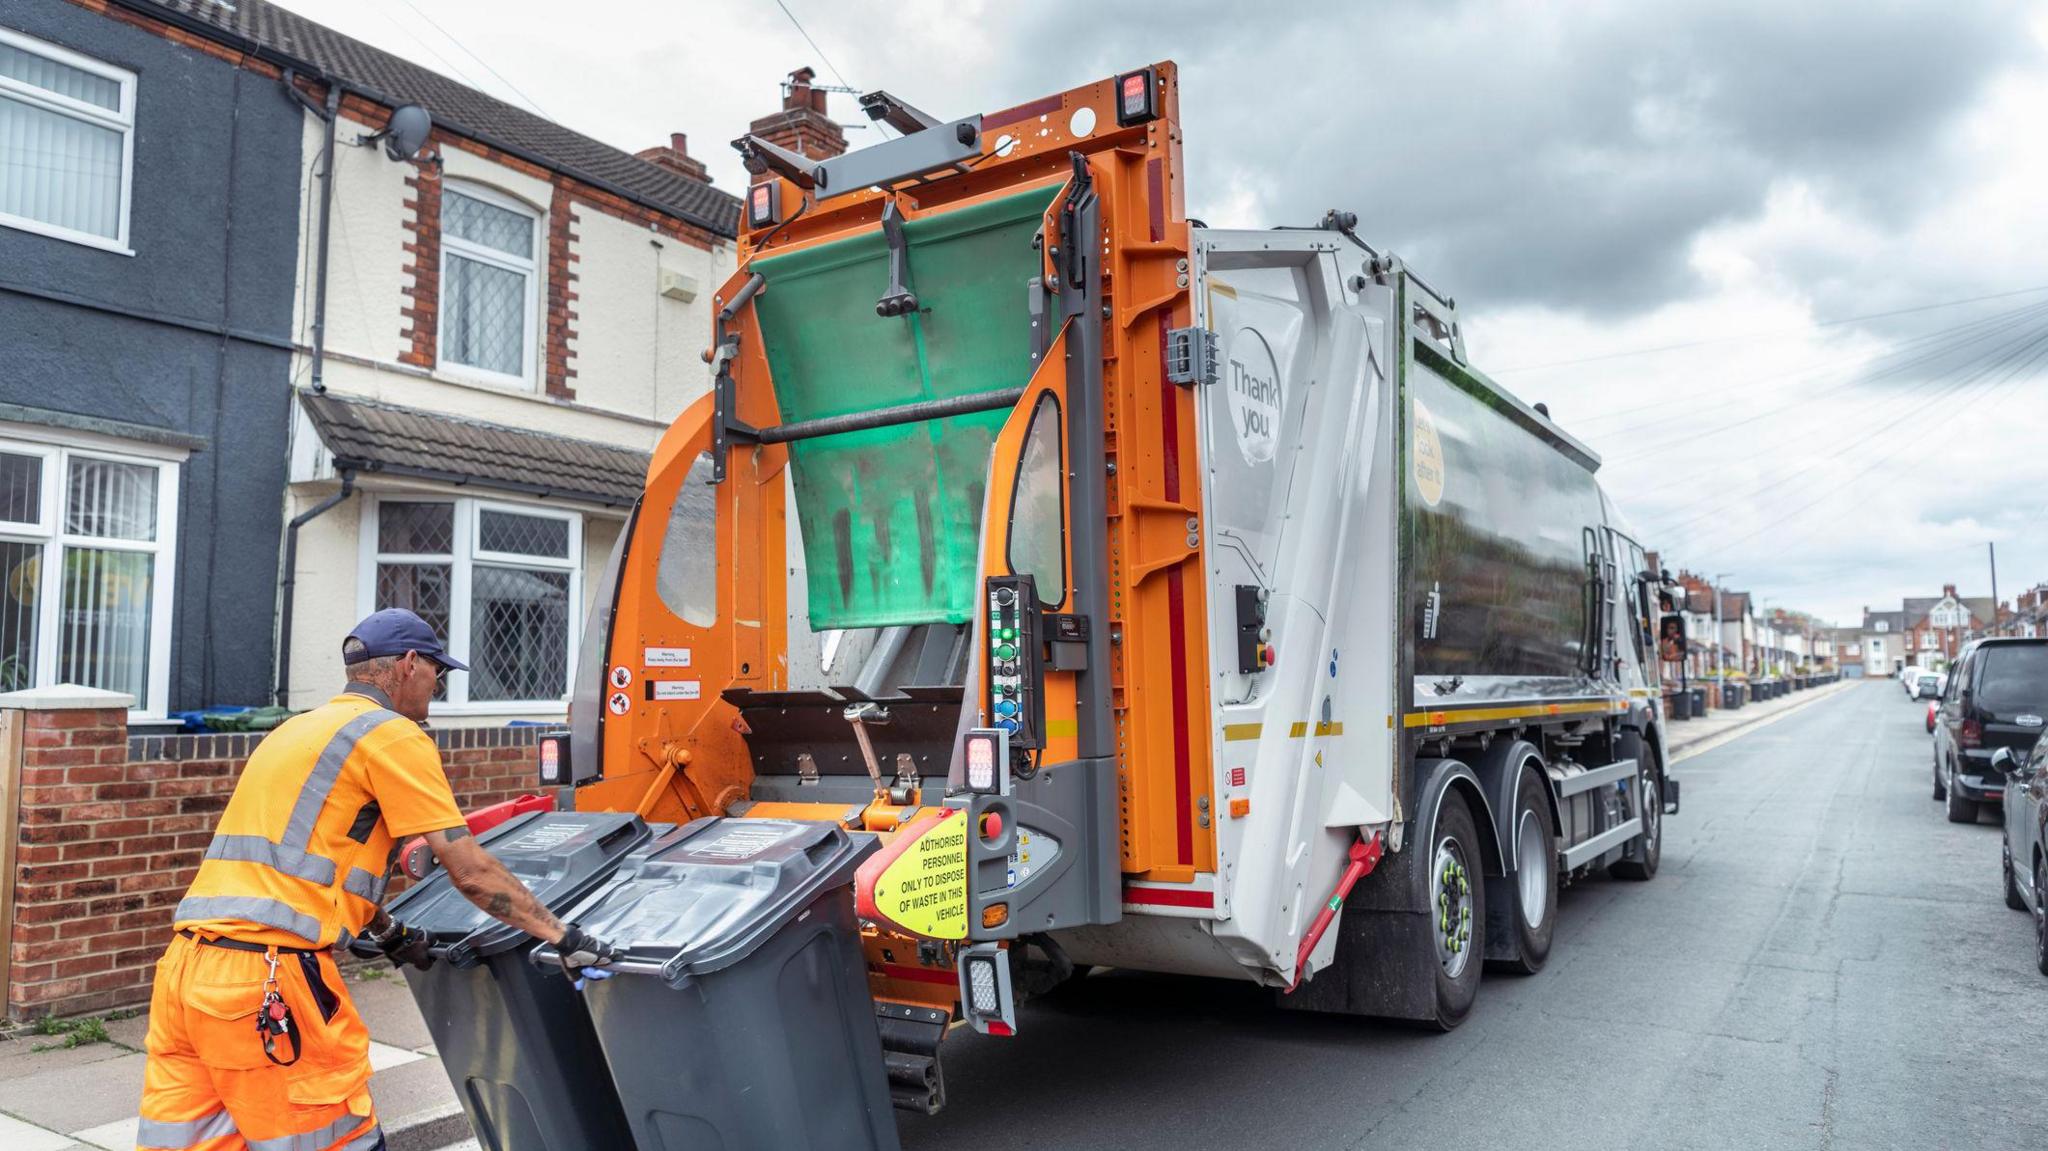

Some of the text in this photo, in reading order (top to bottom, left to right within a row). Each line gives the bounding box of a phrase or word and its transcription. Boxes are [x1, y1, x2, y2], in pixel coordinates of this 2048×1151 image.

[1230, 359, 1278, 409] Thank
[1241, 406, 1270, 439] you
[920, 834, 964, 853] AUTHORISED
[923, 852, 964, 870] PERSONNEL
[901, 869, 964, 894] ONLY TO DISPOSE
[899, 886, 963, 913] OF WASTE IN THIS
[936, 904, 964, 921] VEHICLE
